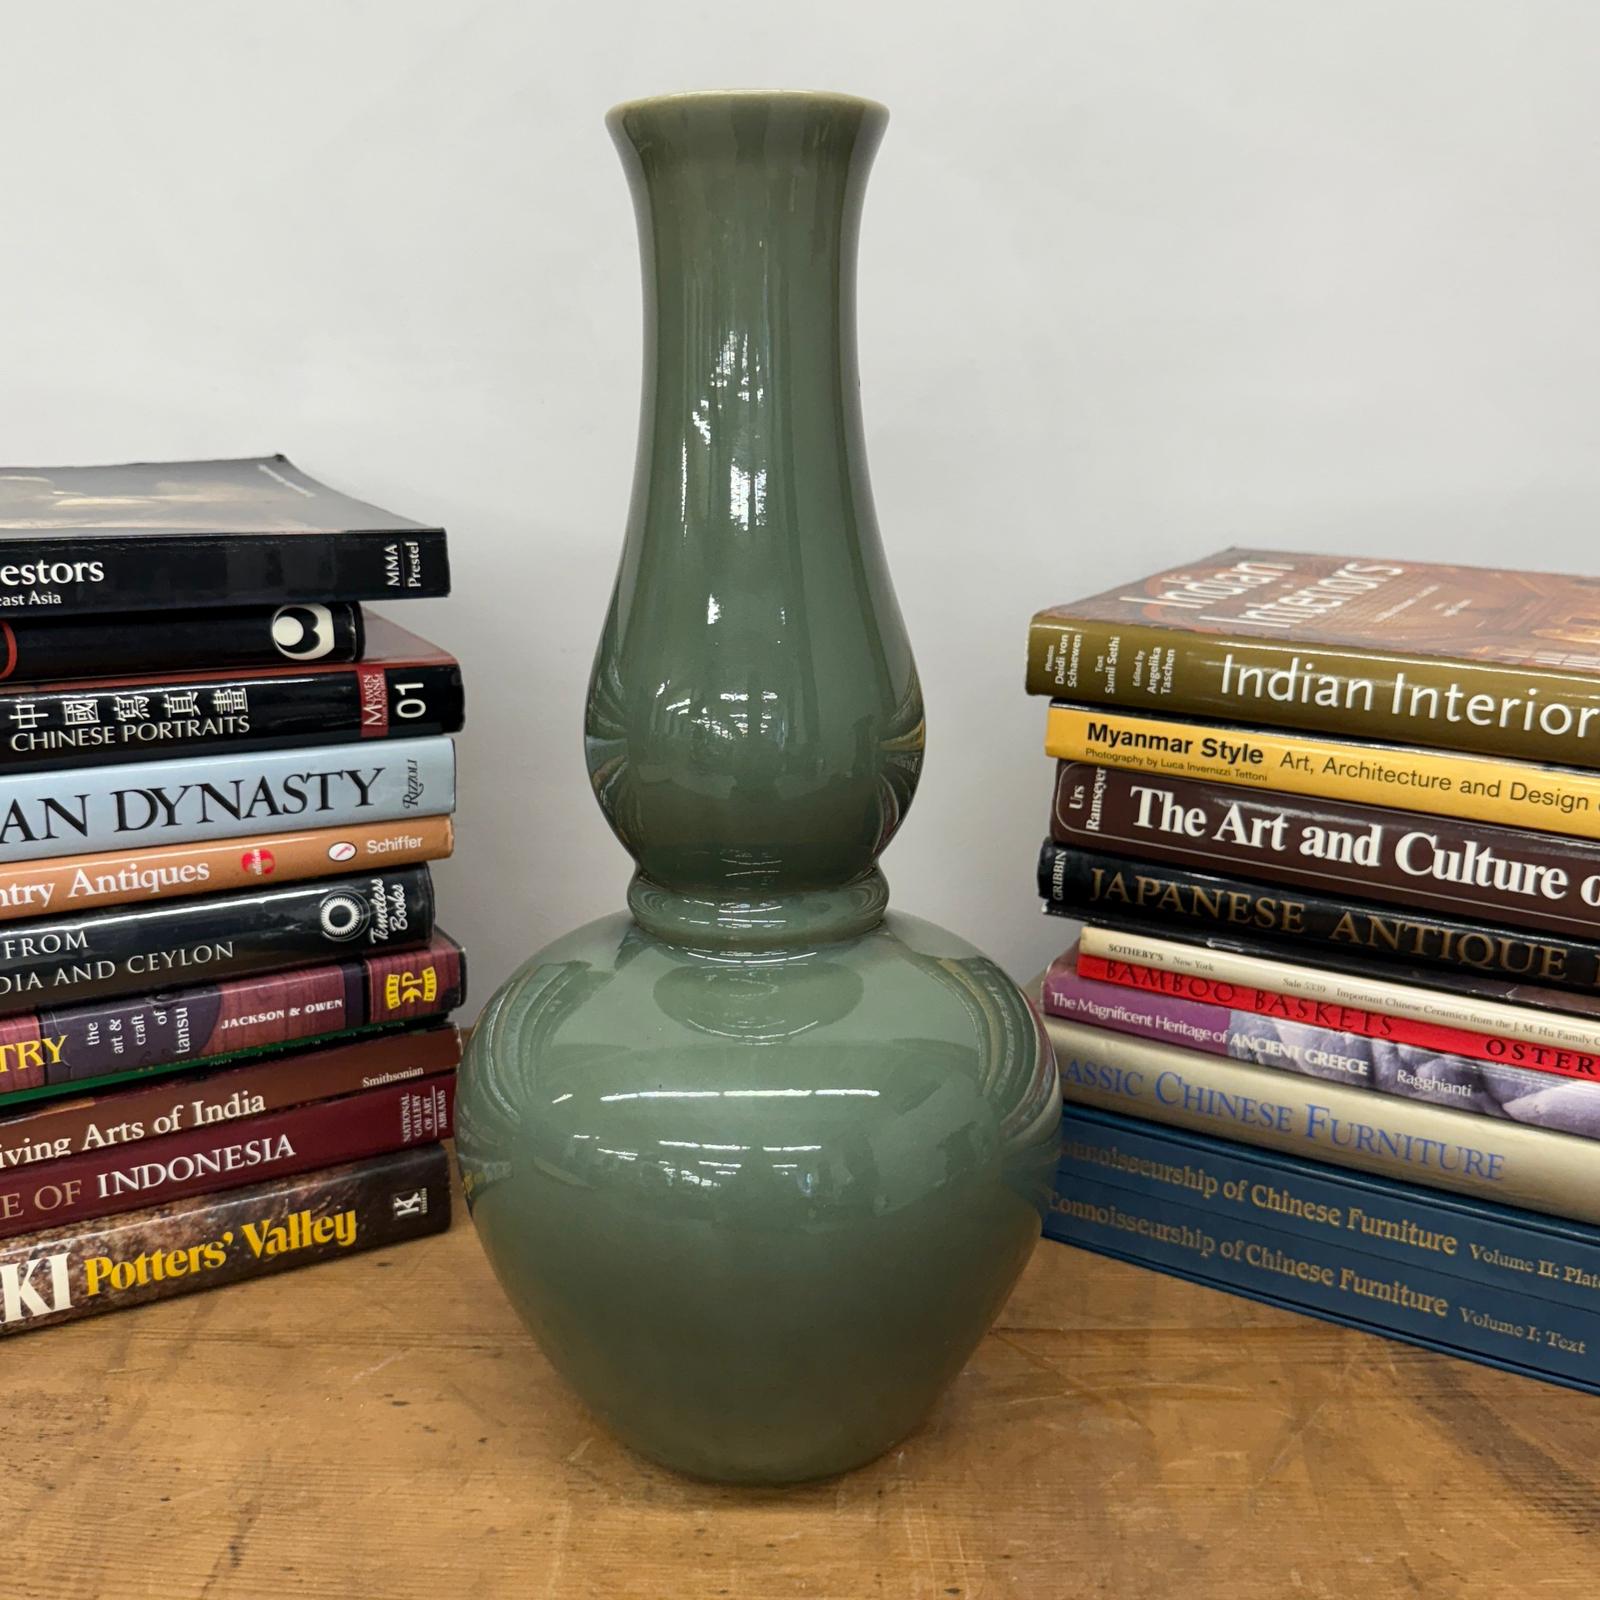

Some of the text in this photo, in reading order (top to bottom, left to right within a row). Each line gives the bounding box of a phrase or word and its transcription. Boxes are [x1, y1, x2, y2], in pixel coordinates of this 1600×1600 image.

[0, 559, 105, 586] estors
[383, 544, 401, 586] MMA
[405, 541, 421, 588] Prestel
[1119, 561, 1295, 609] Indian
[28, 590, 62, 605] Asia
[1198, 562, 1403, 628] Interiors
[1055, 634, 1069, 685] Deidi von
[1067, 634, 1082, 688] Schaewen
[1095, 655, 1104, 673] Text
[1105, 636, 1120, 694] Sunil Sethi
[1132, 650, 1146, 687] Edited by
[1147, 647, 1162, 694] Angelika
[1161, 649, 1176, 694] Taschen
[394, 682, 426, 719] 01
[1221, 653, 1600, 738] Indian Interior
[11, 715, 250, 751] CHINESE PORTRAITS
[1085, 748, 1268, 782] Photography by Luca Invernizzi Tettoni
[1087, 722, 1589, 814] Myanmar Style Art, Architecture and Design
[0, 767, 386, 844] AN DYNASTY
[1069, 784, 1085, 810] Urs
[1086, 768, 1107, 831] Ramseyer
[366, 835, 423, 854] Schiffer
[1130, 785, 1207, 837] The
[1212, 802, 1289, 851] Art
[1299, 823, 1383, 867] and
[1394, 832, 1569, 900] Culture
[67, 863, 210, 898] Antiques
[1052, 850, 1067, 901] GRIBBIN
[370, 878, 388, 944] Timeless
[387, 883, 408, 930] Books
[1090, 867, 1305, 933] JAPANESE
[1329, 911, 1568, 979] ANTIQUE
[4, 931, 89, 959] FROM
[53, 960, 116, 986] AND
[127, 941, 233, 974] CEYLON
[153, 1009, 168, 1026] of
[221, 998, 343, 1030] JACKSON & OWEN
[1105, 960, 1597, 1076] BAMBOO BASKETS OSTER
[1107, 944, 1164, 962] SOTHEBY'S
[1173, 956, 1192, 967] New
[1193, 960, 1214, 972] York
[1282, 977, 1302, 990] Sale
[1336, 988, 1383, 1006] Important
[1385, 995, 1422, 1013] Chinese
[1423, 1006, 1468, 1024] Ceramics
[1470, 1014, 1493, 1026] from
[1495, 1018, 1511, 1029] the
[1538, 1027, 1554, 1038] Hu
[1557, 1030, 1592, 1045] Family
[87, 1021, 100, 1046] the
[109, 1018, 124, 1055] art &
[131, 1013, 146, 1045] craft
[175, 1007, 191, 1055] tansu
[1052, 992, 1369, 1076] The Magnificent Heritage of ANCIENT GREECE
[362, 1066, 424, 1088] Smithsonian
[1397, 1069, 1472, 1097] Ragghianti
[82, 1121, 145, 1150] Arts
[153, 1104, 184, 1134] of
[192, 1090, 266, 1126] India
[400, 1093, 412, 1142] NATIONAL
[412, 1094, 423, 1137] GALLERY
[423, 1097, 434, 1131] OF ART
[437, 1089, 448, 1129] ABRAMS
[1063, 1059, 1505, 1181] ASSIC CHINESE FURNITURE
[34, 1179, 82, 1210] OF
[97, 1134, 297, 1198] INDONESIA
[241, 1209, 358, 1259] Valley
[1223, 1180, 1249, 1202] of
[1252, 1184, 1341, 1227] Chinese
[1347, 1206, 1458, 1255] Furniture
[1469, 1243, 1534, 1272] Volume
[1219, 1240, 1244, 1261] of
[1245, 1244, 1335, 1286] Chinese
[1339, 1267, 1449, 1317] Furniture
[1459, 1306, 1524, 1338] Volume
[1546, 1330, 1587, 1355] Text
